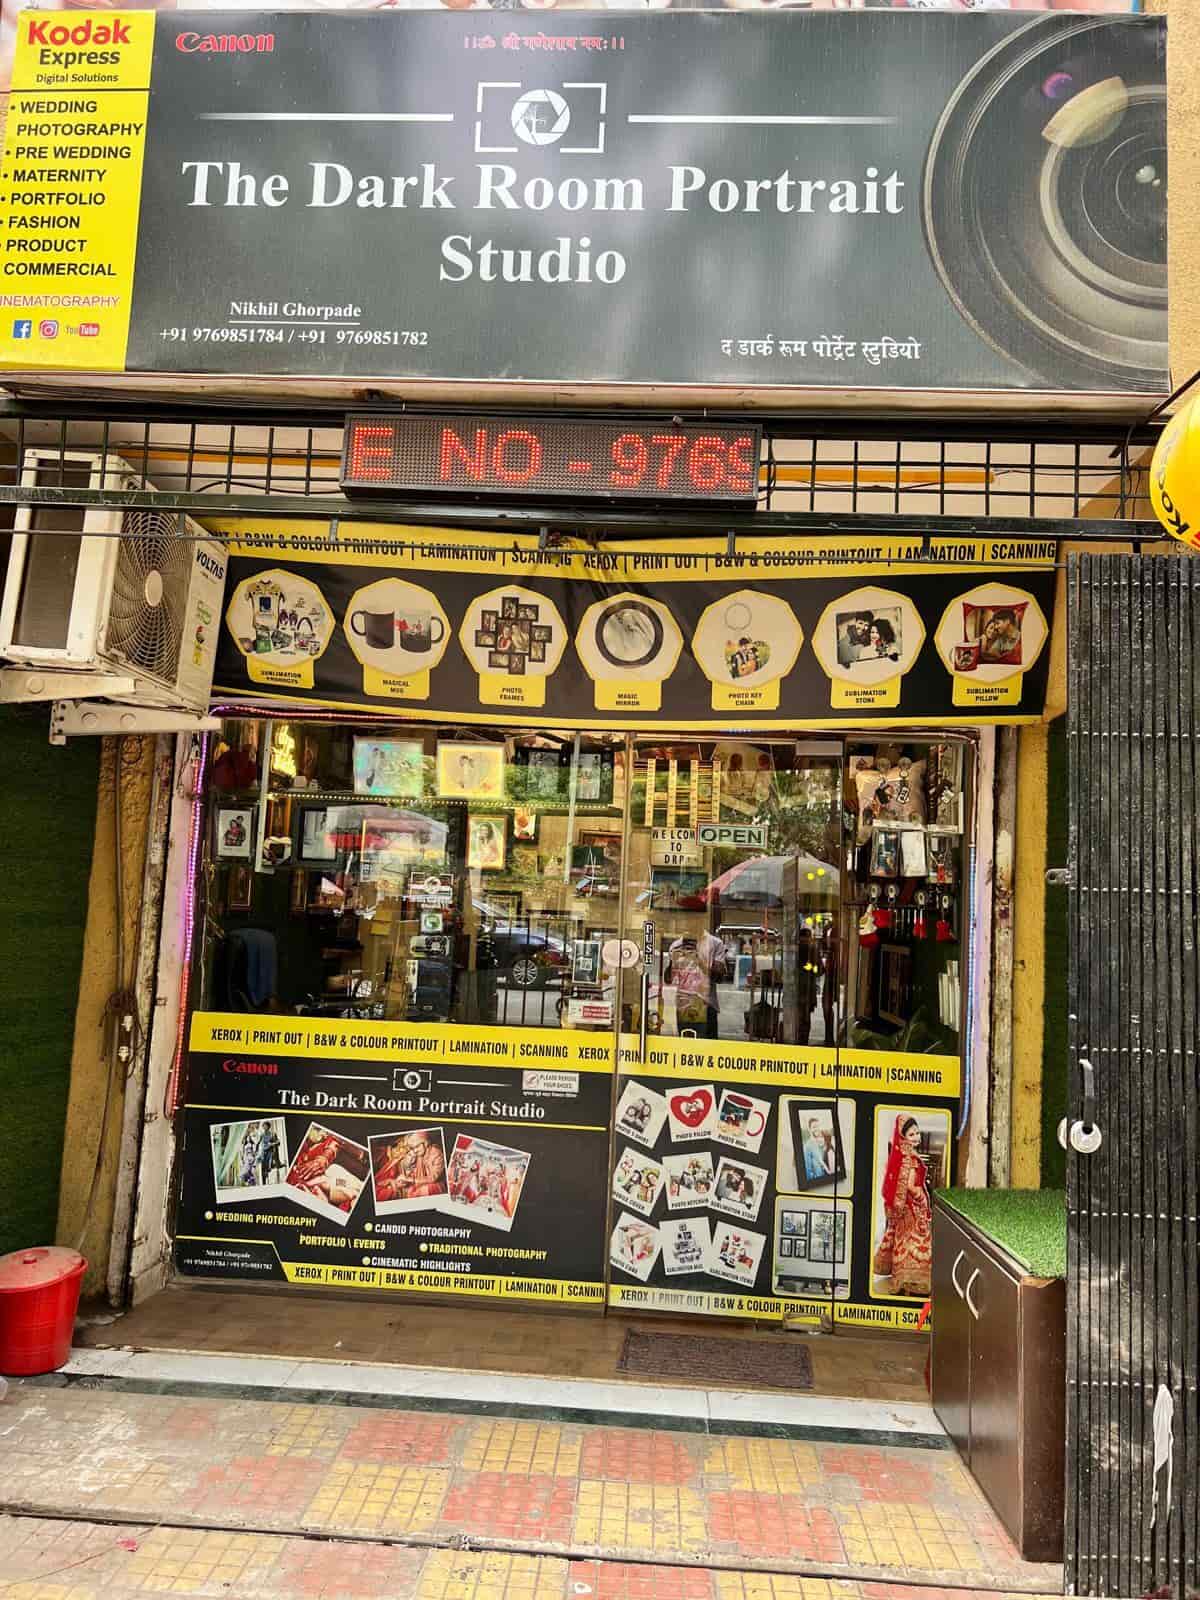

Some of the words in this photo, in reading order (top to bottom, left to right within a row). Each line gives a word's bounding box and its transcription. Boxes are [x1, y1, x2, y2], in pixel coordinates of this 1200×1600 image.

[28, 19, 130, 46] Kodak
[175, 32, 275, 52] Canon
[39, 49, 120, 69] Express
[36, 73, 69, 84] Digital
[72, 72, 119, 83] Solutions
[20, 101, 98, 114] WEDDING
[17, 123, 144, 136] PHOTOGRAPHY
[15, 147, 49, 160] PRE
[53, 146, 131, 159] WEDDING
[13, 169, 107, 182] MATERNITY
[182, 161, 289, 208] The
[306, 161, 456, 210] Dark
[473, 164, 646, 212] Room
[664, 165, 905, 214] Portrait
[11, 192, 105, 206] PORTFOLIO
[8, 216, 81, 229] FASHION
[6, 239, 87, 252] PRODUCT
[440, 234, 627, 284] Studio
[4, 262, 117, 276] COMMERCIAL
[0, 295, 120, 307] INEMATOGRAPHY
[230, 301, 279, 317] Nikhil
[283, 302, 361, 322] Ghorpade
[160, 329, 188, 343] +91
[193, 329, 285, 343] 9769851784
[298, 331, 326, 344] +91
[336, 331, 428, 346] 9769851782
[720, 339, 734, 357] द
[738, 334, 774, 357] डार्क
[779, 340, 808, 357] रूम
[861, 336, 922, 365] स्टुडियो
[353, 427, 394, 479] E
[440, 428, 542, 481] NO
[344, 537, 406, 557] PRINTOUT
[421, 541, 496, 562] LAMINATION
[584, 551, 618, 570] XEROX
[633, 553, 669, 569] PRINT
[675, 554, 698, 569] OUT
[715, 552, 746, 568] B&W
[763, 550, 814, 567] COLOUR
[819, 547, 883, 565] PRINTOUT
[991, 542, 1056, 560] SCANNING
[196, 548, 225, 581] VOLTAS
[701, 828, 762, 844] OPEN
[670, 842, 682, 852] TO
[645, 923, 653, 963] PUSH
[211, 1028, 242, 1042] XEROX
[253, 1031, 282, 1044] PRINT
[284, 1032, 304, 1045] OUT
[314, 1034, 337, 1047] B&W
[340, 1035, 347, 1047] &
[350, 1035, 388, 1049] COLOUR
[391, 1038, 438, 1051] PRINTOUT
[449, 1040, 508, 1055] LAMINATION
[520, 1044, 568, 1058] SCANNING
[578, 1047, 609, 1060] XEROX
[619, 1050, 646, 1064] PRIN
[650, 1051, 669, 1065] OUT
[681, 1054, 704, 1068] B&W
[707, 1055, 714, 1068] &
[718, 1056, 757, 1071] COLOUR
[760, 1060, 808, 1075] PRINTOUT
[821, 1063, 882, 1079] LAMINATION
[891, 1068, 942, 1083] SCANNING
[222, 1059, 278, 1075] Canon
[278, 1089, 310, 1106] The
[315, 1091, 358, 1108] Dark
[364, 1094, 412, 1111] Room
[418, 1097, 485, 1116] Portrait
[490, 1101, 545, 1119] Studio
[216, 1212, 254, 1223] WEDDING
[256, 1214, 318, 1227] PHOTOGRAPHY
[375, 1223, 406, 1235] CANDID
[409, 1225, 472, 1238] PHOTOGRAPHY
[299, 1235, 346, 1247] PORTFOLIO
[353, 1239, 386, 1250] EVENTS
[429, 1243, 483, 1256] TRADITIONAL
[486, 1248, 547, 1261] PHOTOGRAPHY
[371, 1256, 418, 1269] CINEMATIC
[420, 1259, 472, 1272] HIGHLIGHTS
[295, 1267, 322, 1280] XEROX
[332, 1270, 356, 1282] PRINT
[359, 1271, 376, 1283] OUT
[386, 1273, 405, 1284] B&W
[408, 1275, 415, 1285] &
[417, 1275, 451, 1288] COLOUR
[454, 1277, 495, 1291] PRINTOUT
[505, 1281, 557, 1295] LAMINATION
[567, 1285, 605, 1298] SCANNIN
[620, 1288, 648, 1301] XEROX
[659, 1292, 685, 1306] PRINT
[687, 1295, 704, 1307] OUT
[713, 1298, 735, 1310] B&W
[737, 1299, 744, 1311] &
[746, 1300, 781, 1313] COLOUR
[784, 1302, 827, 1315] PRINTOUT
[838, 1307, 891, 1322] LAMINATION
